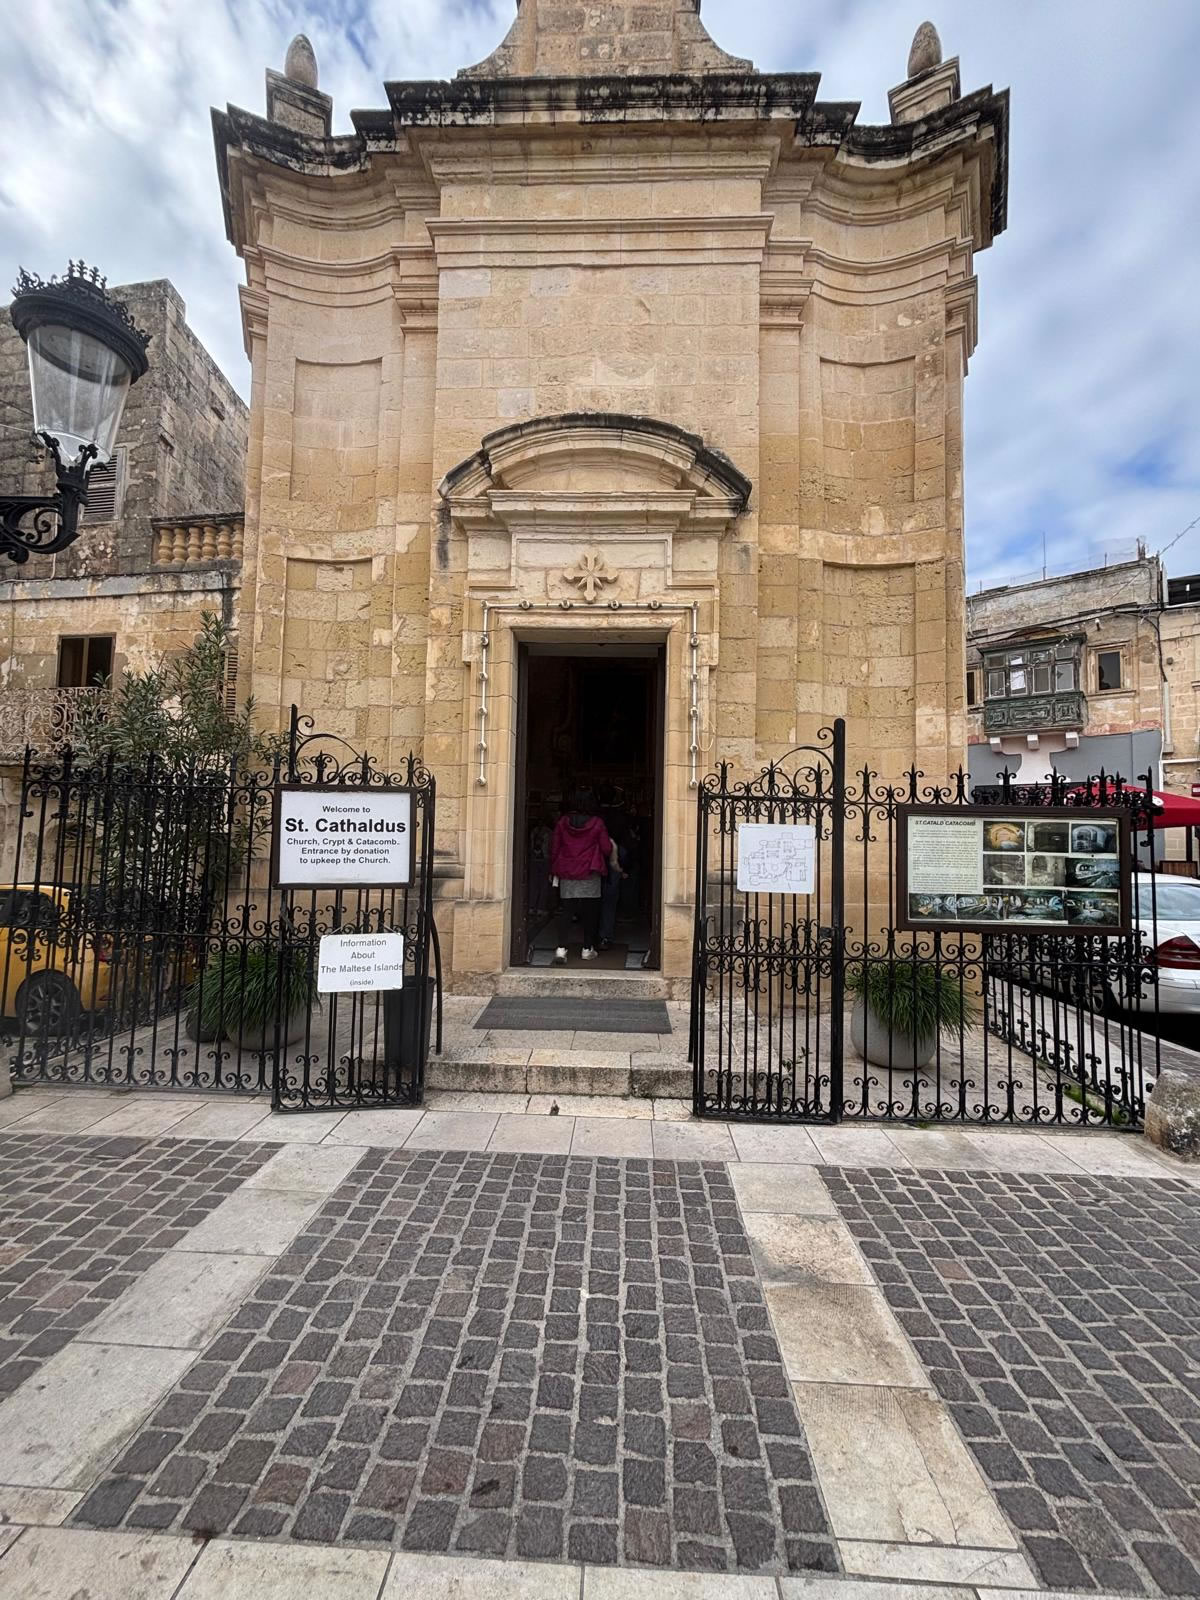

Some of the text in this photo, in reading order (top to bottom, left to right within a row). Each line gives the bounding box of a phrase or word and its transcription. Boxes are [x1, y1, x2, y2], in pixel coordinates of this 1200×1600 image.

[322, 805, 361, 813] Welcome
[285, 818, 406, 833] St. Cathaldus
[286, 837, 401, 847] Church, Crypt & Catacomb.
[301, 847, 390, 856] Entrance by donation
[310, 857, 341, 865] upkeep
[358, 856, 391, 864] Church.
[340, 939, 387, 947] Information
[350, 951, 376, 959] About
[320, 963, 404, 974] The Maltese Islands
